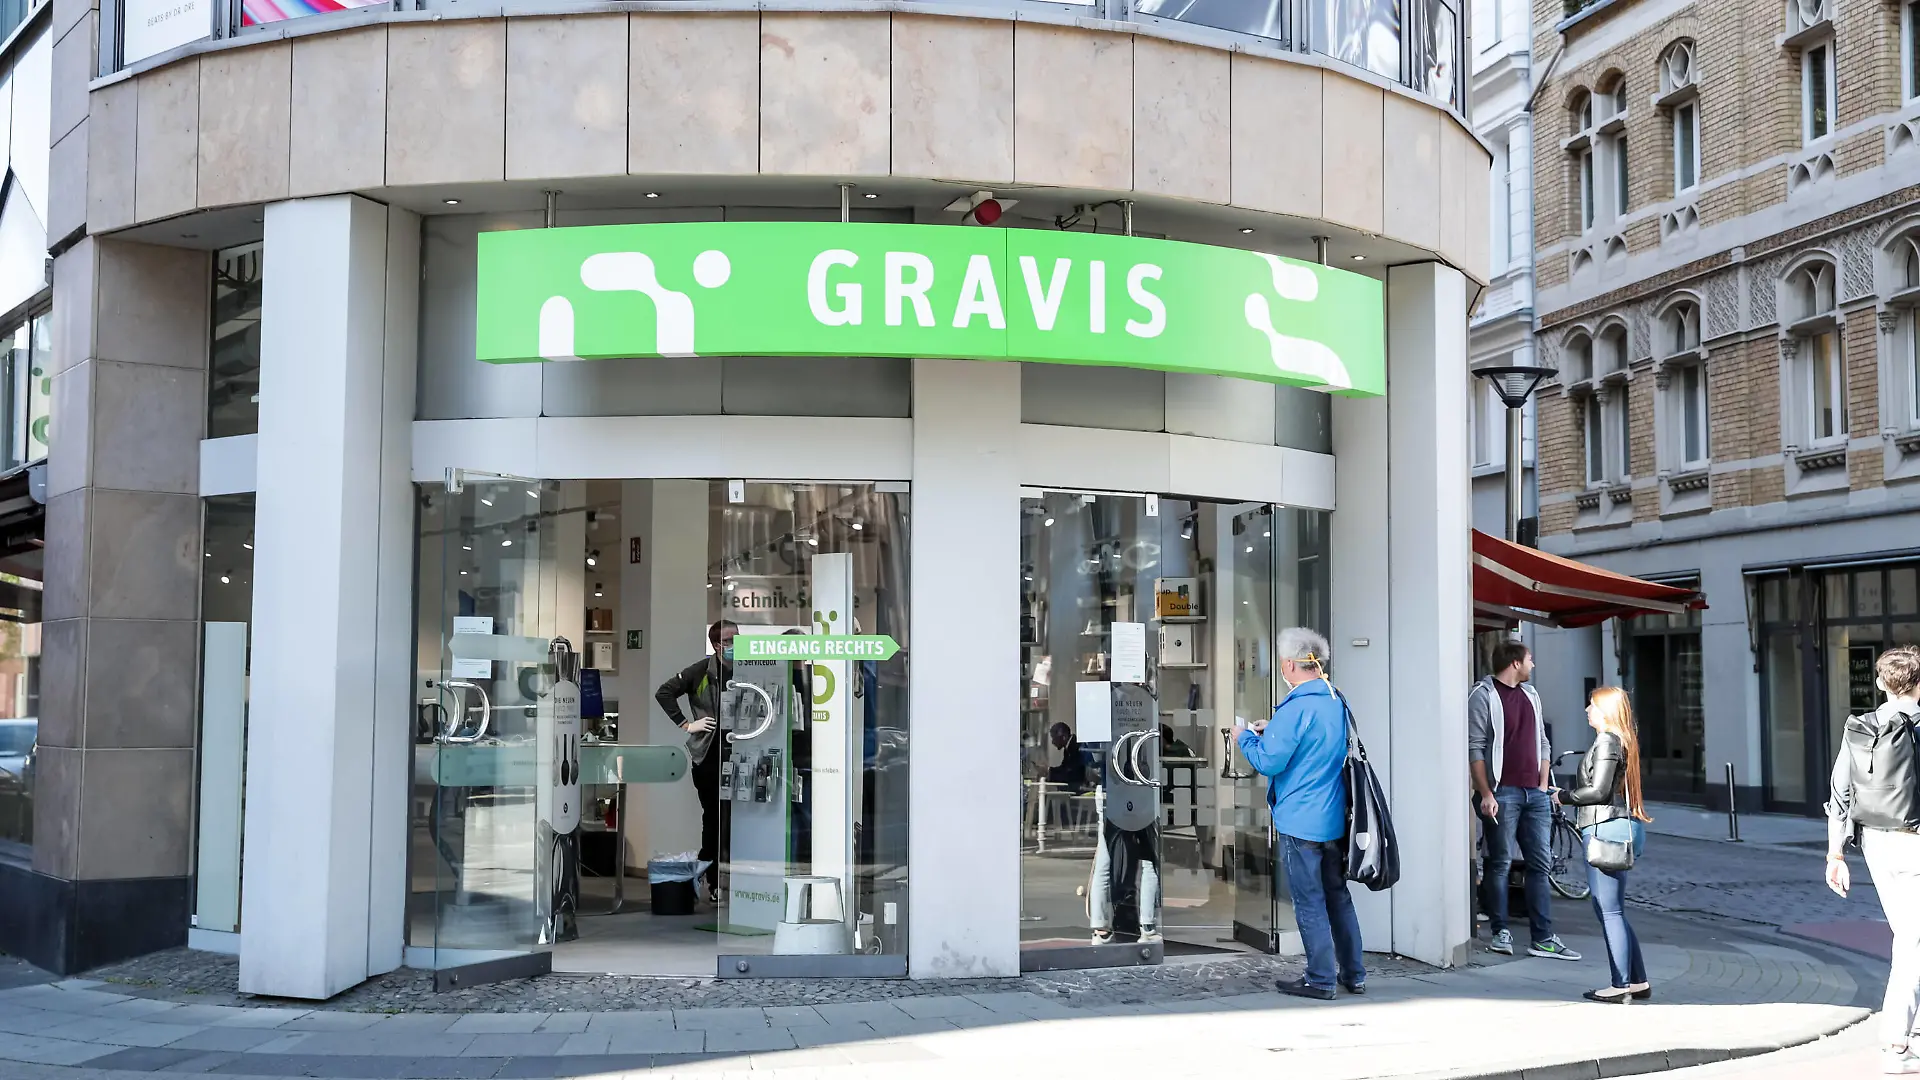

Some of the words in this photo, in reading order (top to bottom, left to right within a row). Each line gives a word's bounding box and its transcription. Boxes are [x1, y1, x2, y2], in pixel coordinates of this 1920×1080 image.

[807, 249, 1167, 338] GRAVIS
[750, 641, 820, 655] EINGANG
[826, 641, 884, 655] RECHTS
[734, 890, 780, 903] www.gravis.de
